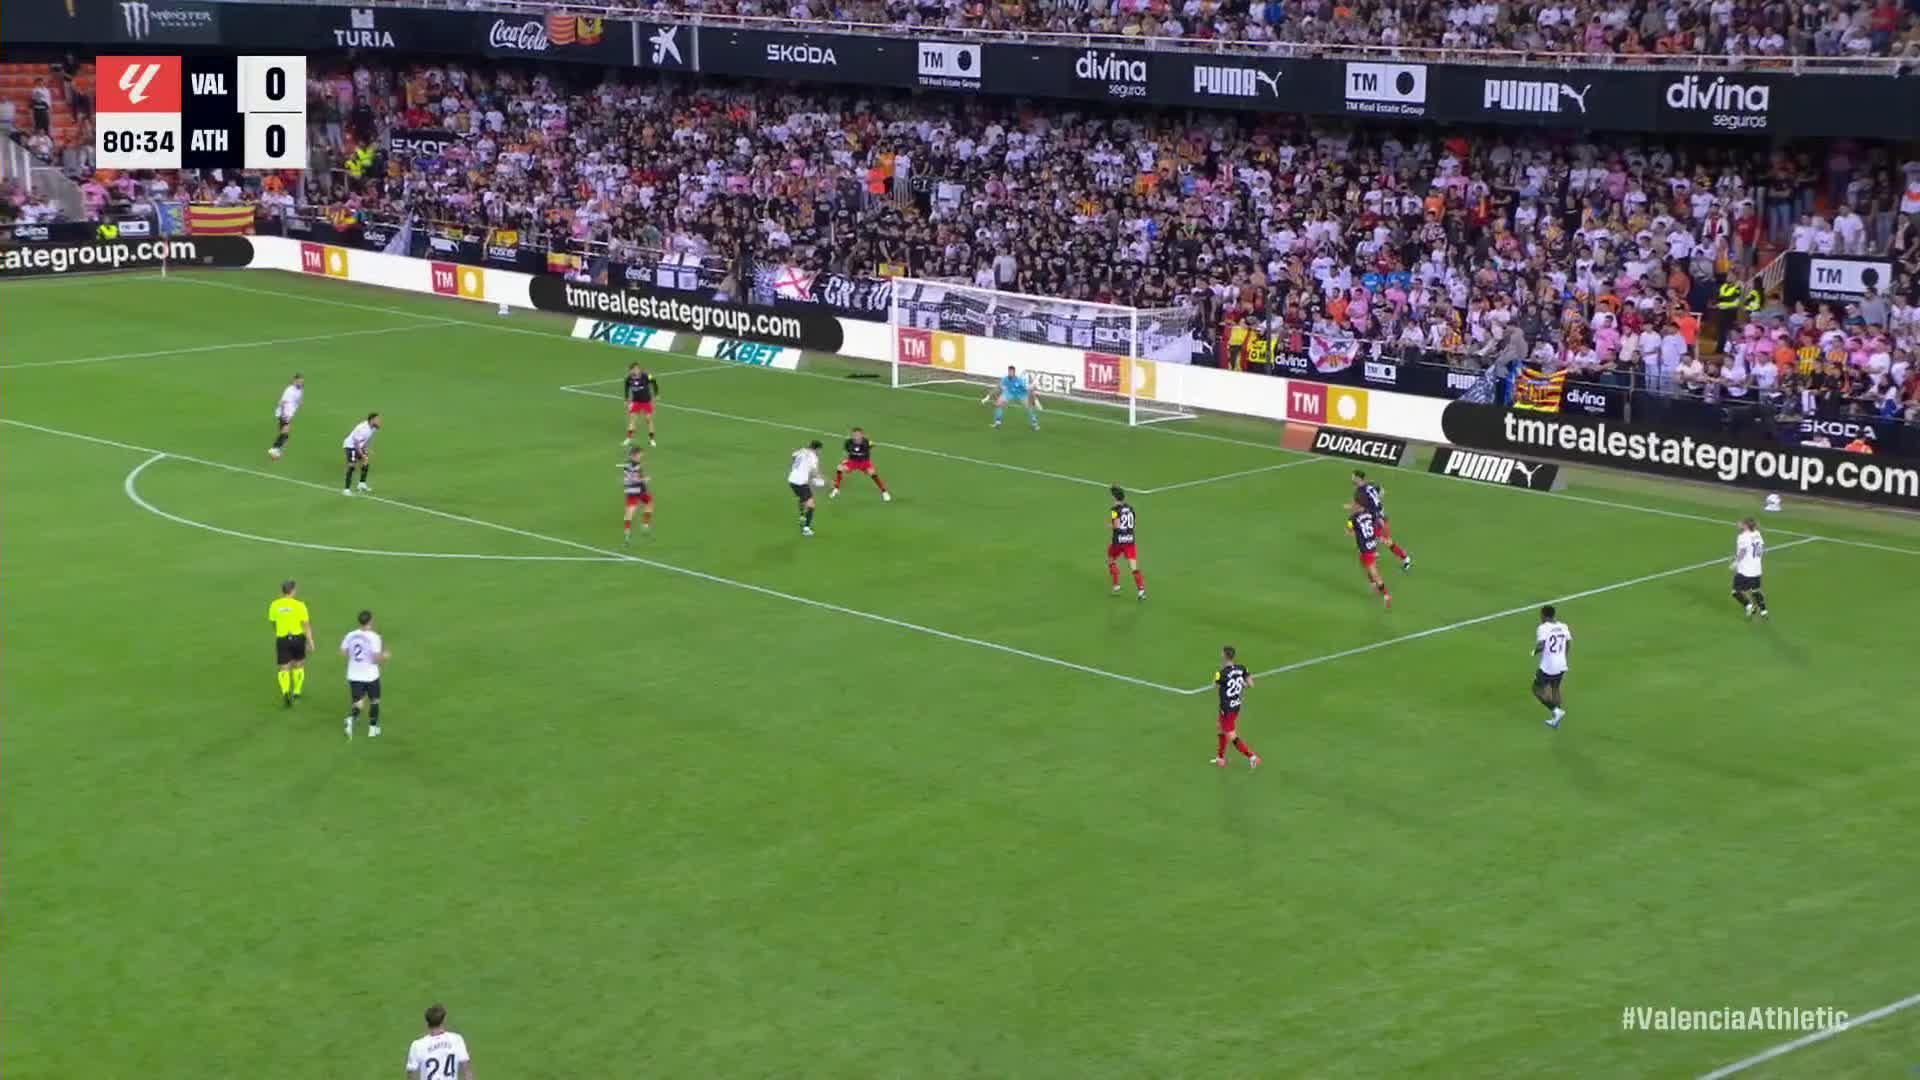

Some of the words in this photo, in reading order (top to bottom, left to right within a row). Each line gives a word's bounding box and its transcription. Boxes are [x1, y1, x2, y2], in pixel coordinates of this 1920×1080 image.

[334, 30, 395, 48] TURIA
[923, 51, 944, 69] TM
[1075, 51, 1147, 82] divina
[1109, 84, 1147, 98] seguros
[1194, 66, 1257, 97] PUMA
[1352, 72, 1378, 92] TM
[1484, 79, 1560, 113] PUMA
[1666, 75, 1770, 112] divina
[1712, 114, 1768, 129] seguros
[304, 251, 321, 268] TM
[435, 270, 454, 288] TM
[1816, 267, 1842, 284] TM
[565, 284, 801, 339] tmrealestategroup.com
[589, 320, 658, 348] 1XBET
[714, 339, 785, 367] 1XBET
[902, 337, 925, 358] TM
[1089, 362, 1113, 385] TM
[1292, 390, 1320, 416] TM
[1317, 432, 1398, 461] DURACELL
[1504, 411, 1919, 496] tmrealestategroup.com
[1444, 450, 1515, 484] PUMA
[1121, 511, 1134, 529] 20
[353, 643, 364, 662] 2
[1549, 634, 1565, 654] 27
[425, 1053, 456, 1080] 24
